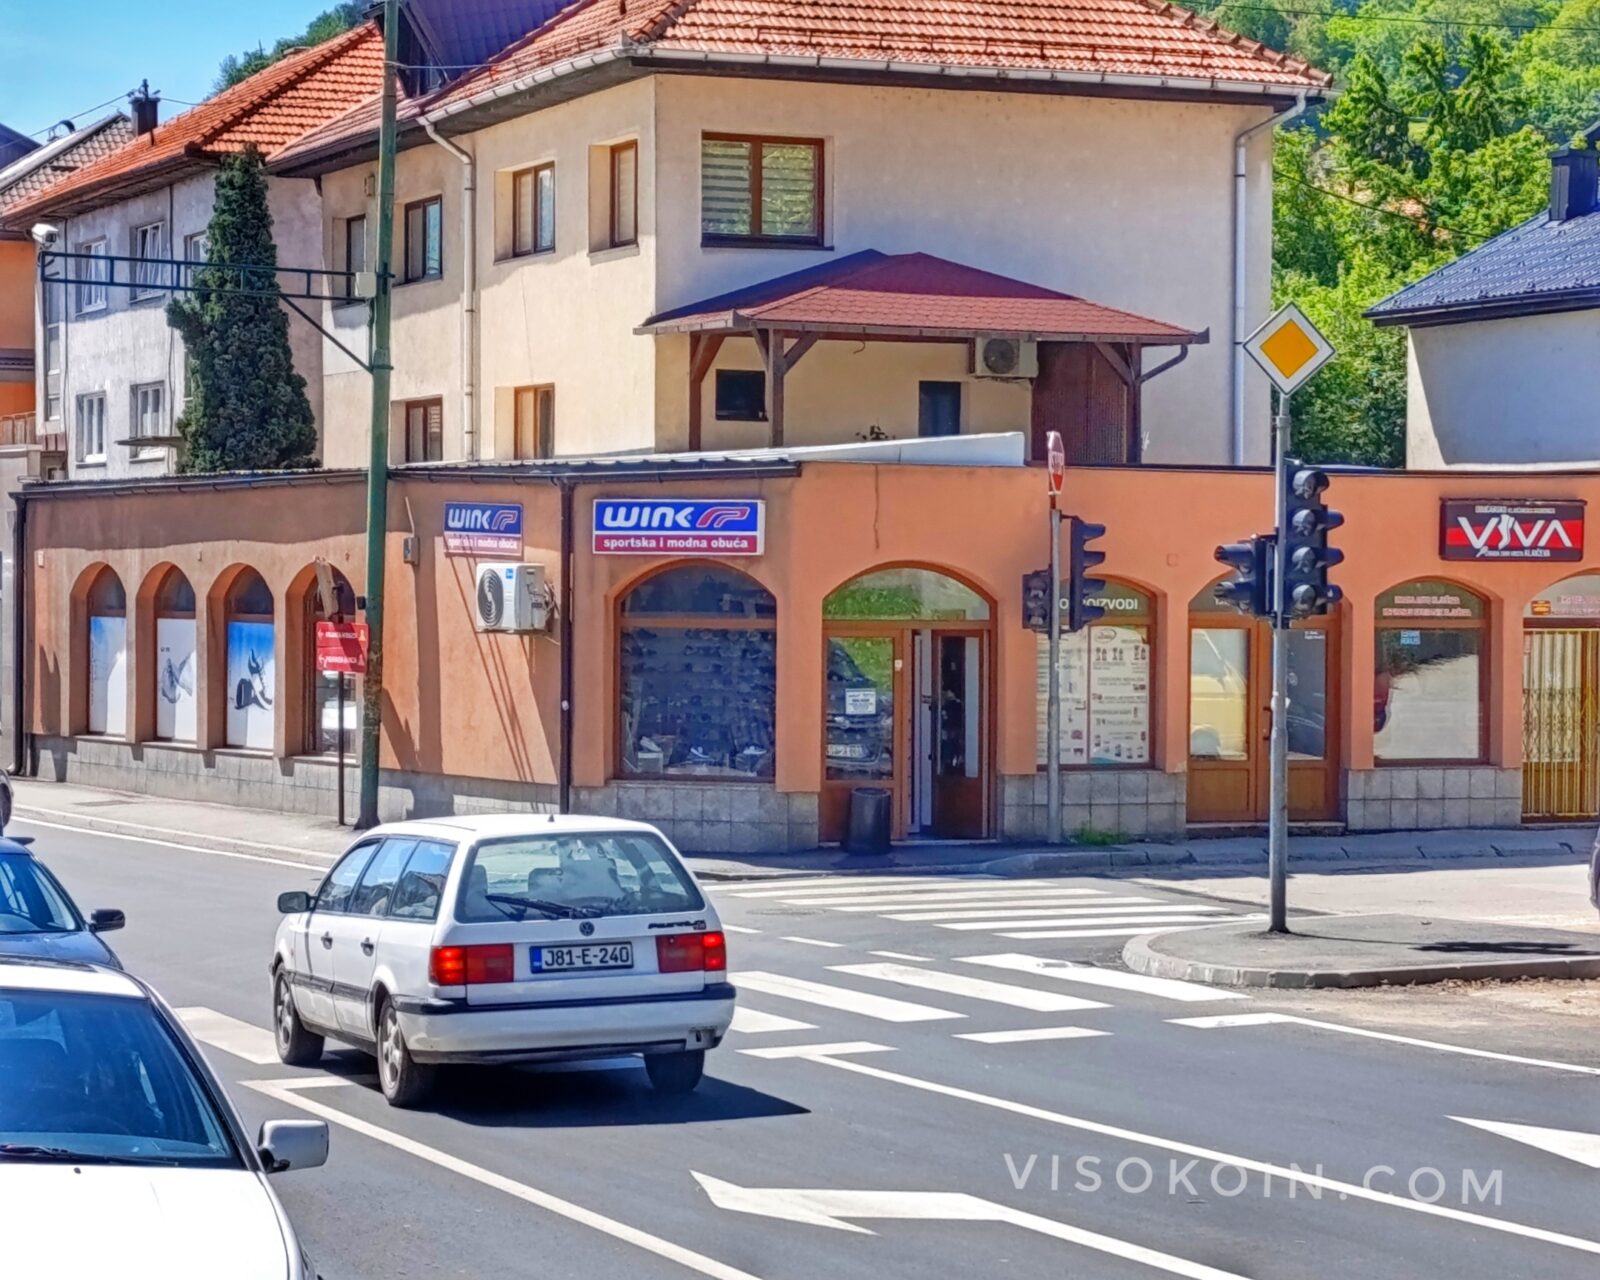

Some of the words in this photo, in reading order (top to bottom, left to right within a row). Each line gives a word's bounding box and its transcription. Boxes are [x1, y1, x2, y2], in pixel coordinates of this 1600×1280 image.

[1457, 514, 1573, 549] VIVA
[603, 537, 656, 550] sportska
[659, 537, 664, 548] i
[667, 537, 708, 549] modna
[711, 537, 749, 549] obuća
[545, 946, 630, 966] J81-E-240
